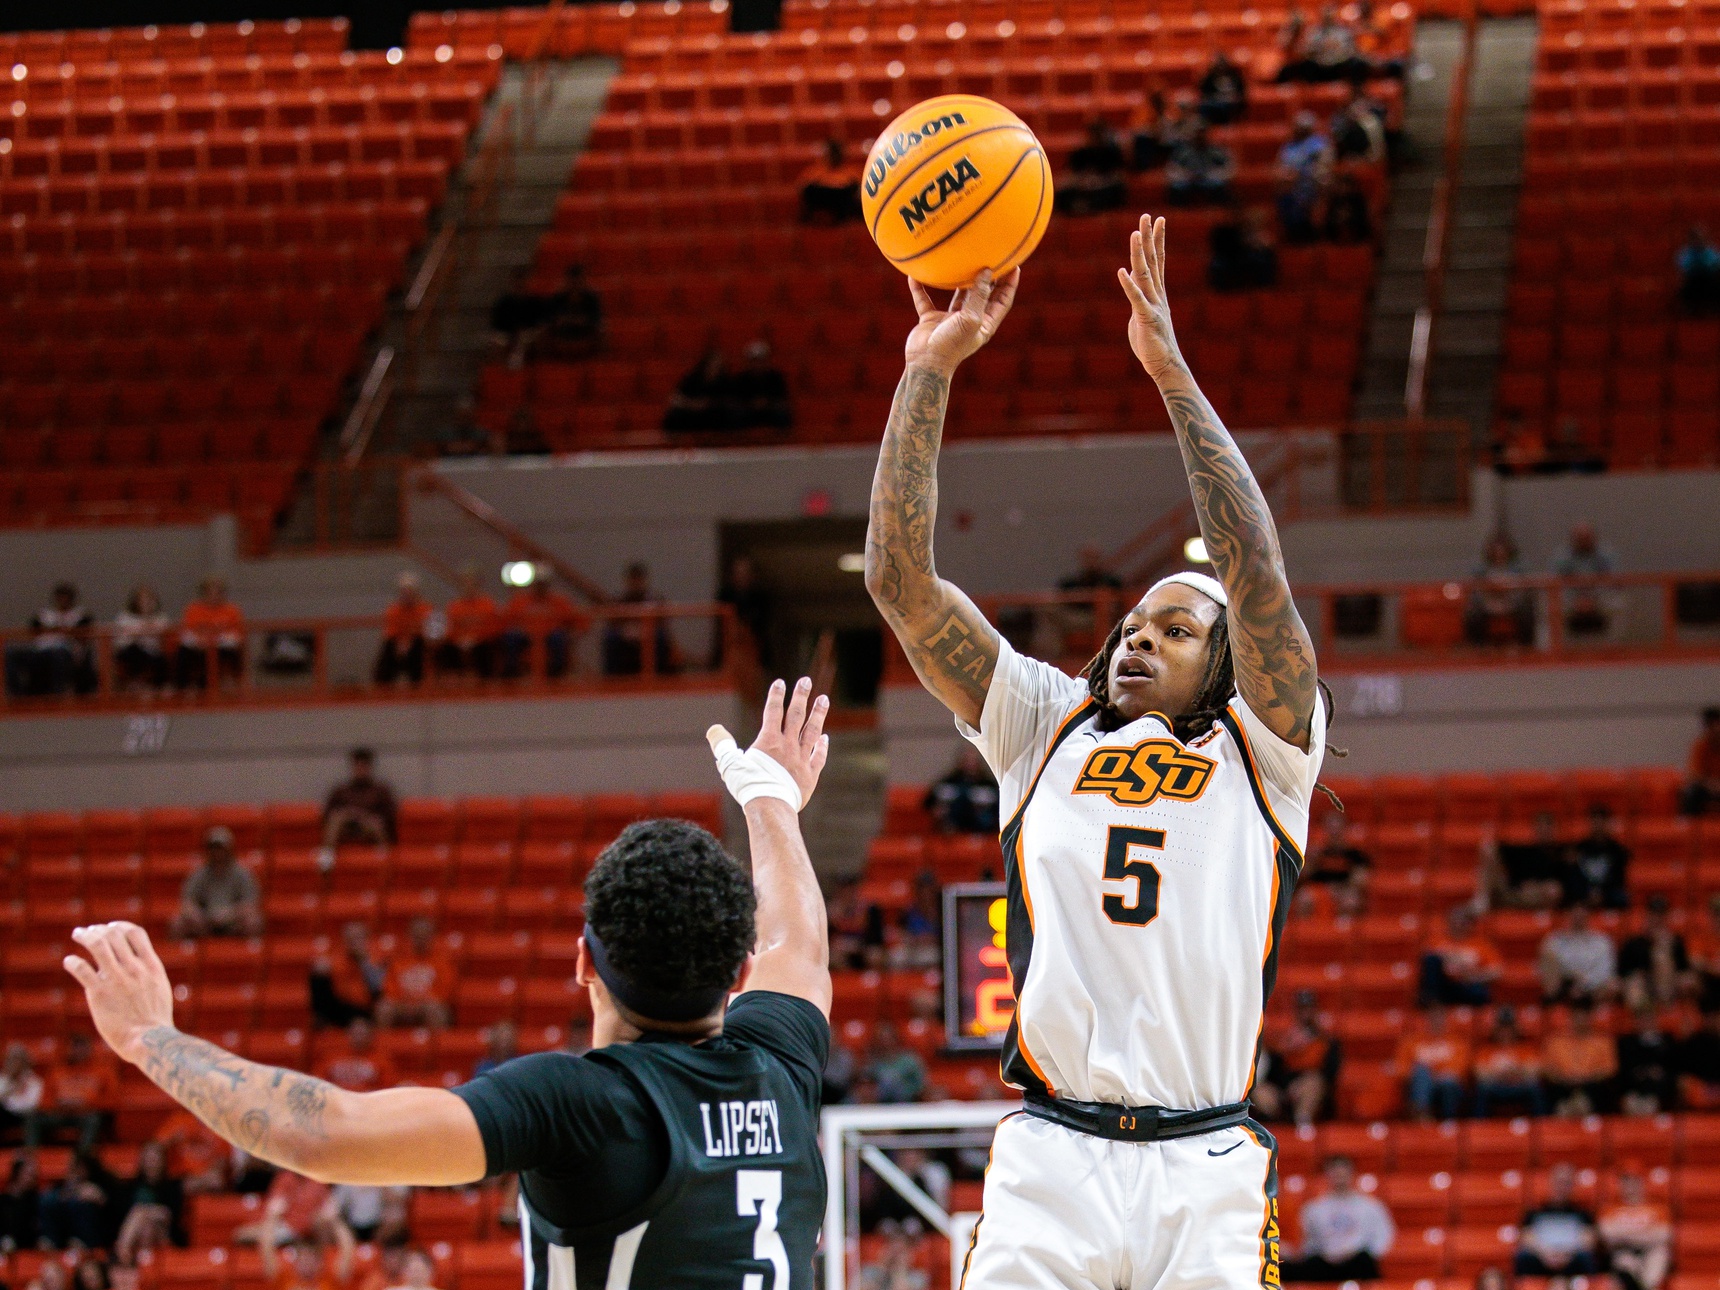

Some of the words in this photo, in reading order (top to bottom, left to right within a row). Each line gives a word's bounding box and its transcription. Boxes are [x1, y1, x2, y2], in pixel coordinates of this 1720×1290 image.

[899, 156, 981, 234] NCAA
[1071, 738, 1218, 808] OSU
[1102, 824, 1167, 928] 5
[700, 1099, 784, 1157] LIPSEY
